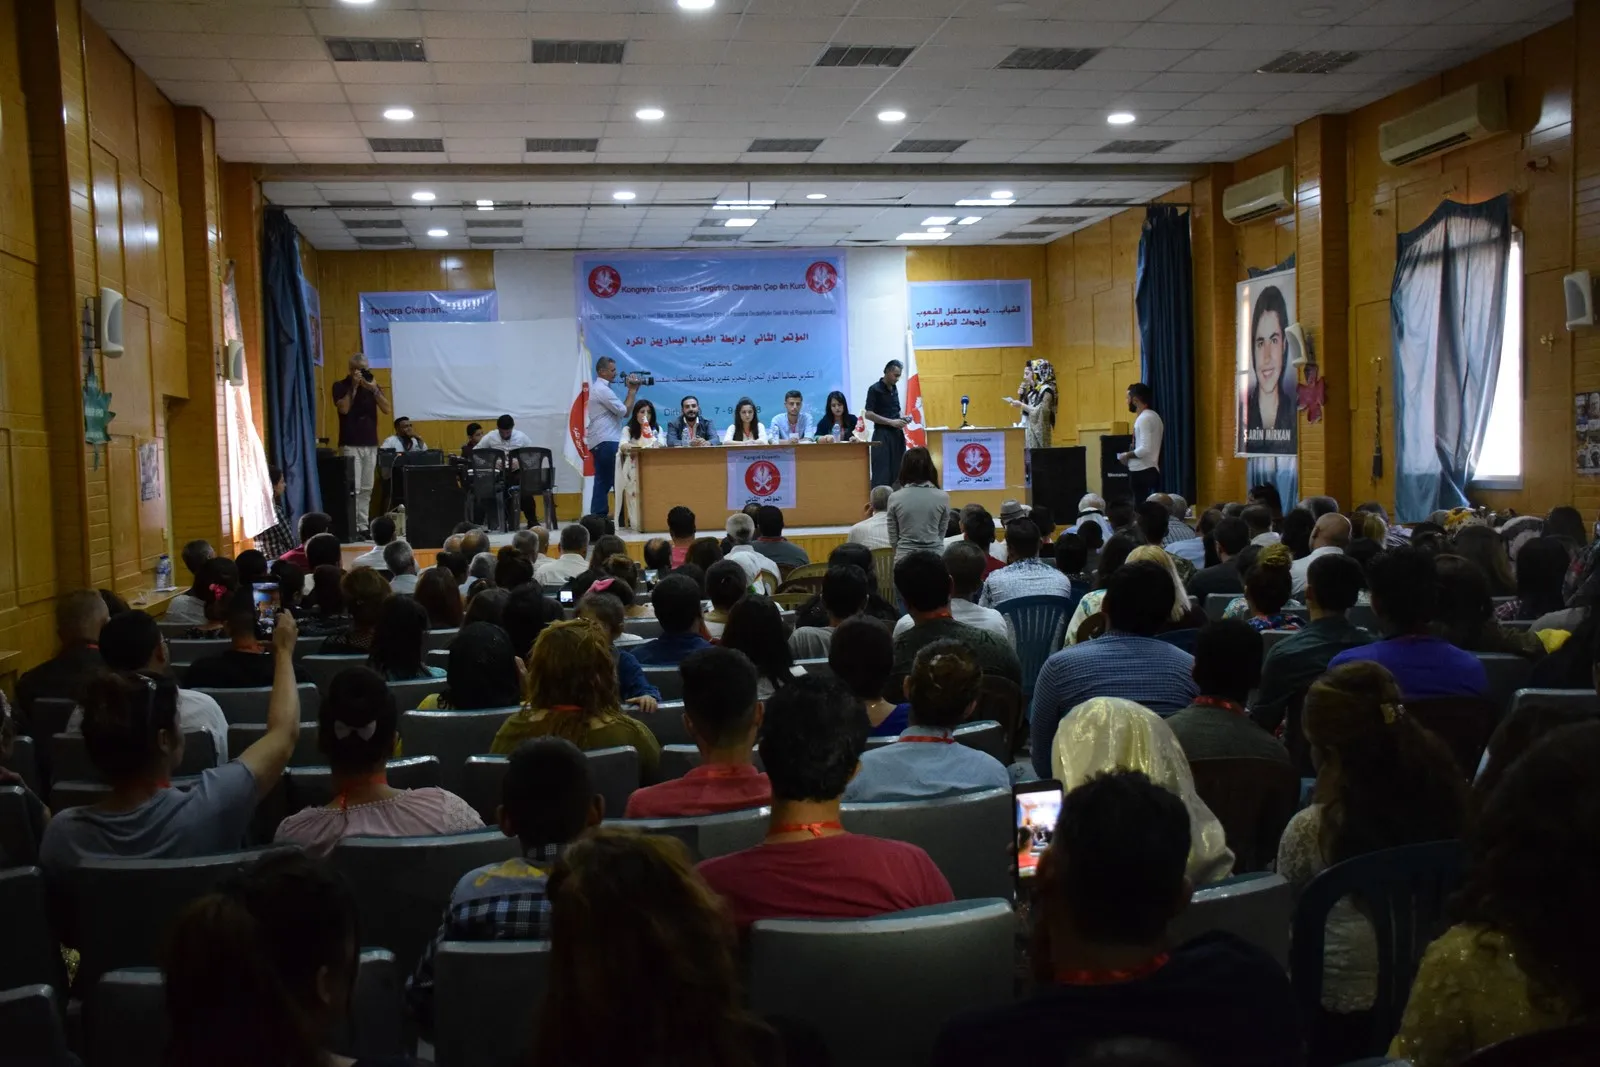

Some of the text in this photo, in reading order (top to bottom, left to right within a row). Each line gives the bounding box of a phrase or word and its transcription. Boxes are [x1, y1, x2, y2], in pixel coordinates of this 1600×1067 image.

[789, 282, 807, 290] Kurd
[625, 336, 647, 347] الكرد
[690, 334, 717, 346] الشباب
[753, 332, 777, 346] الثاني
[781, 332, 809, 343] المؤتمر
